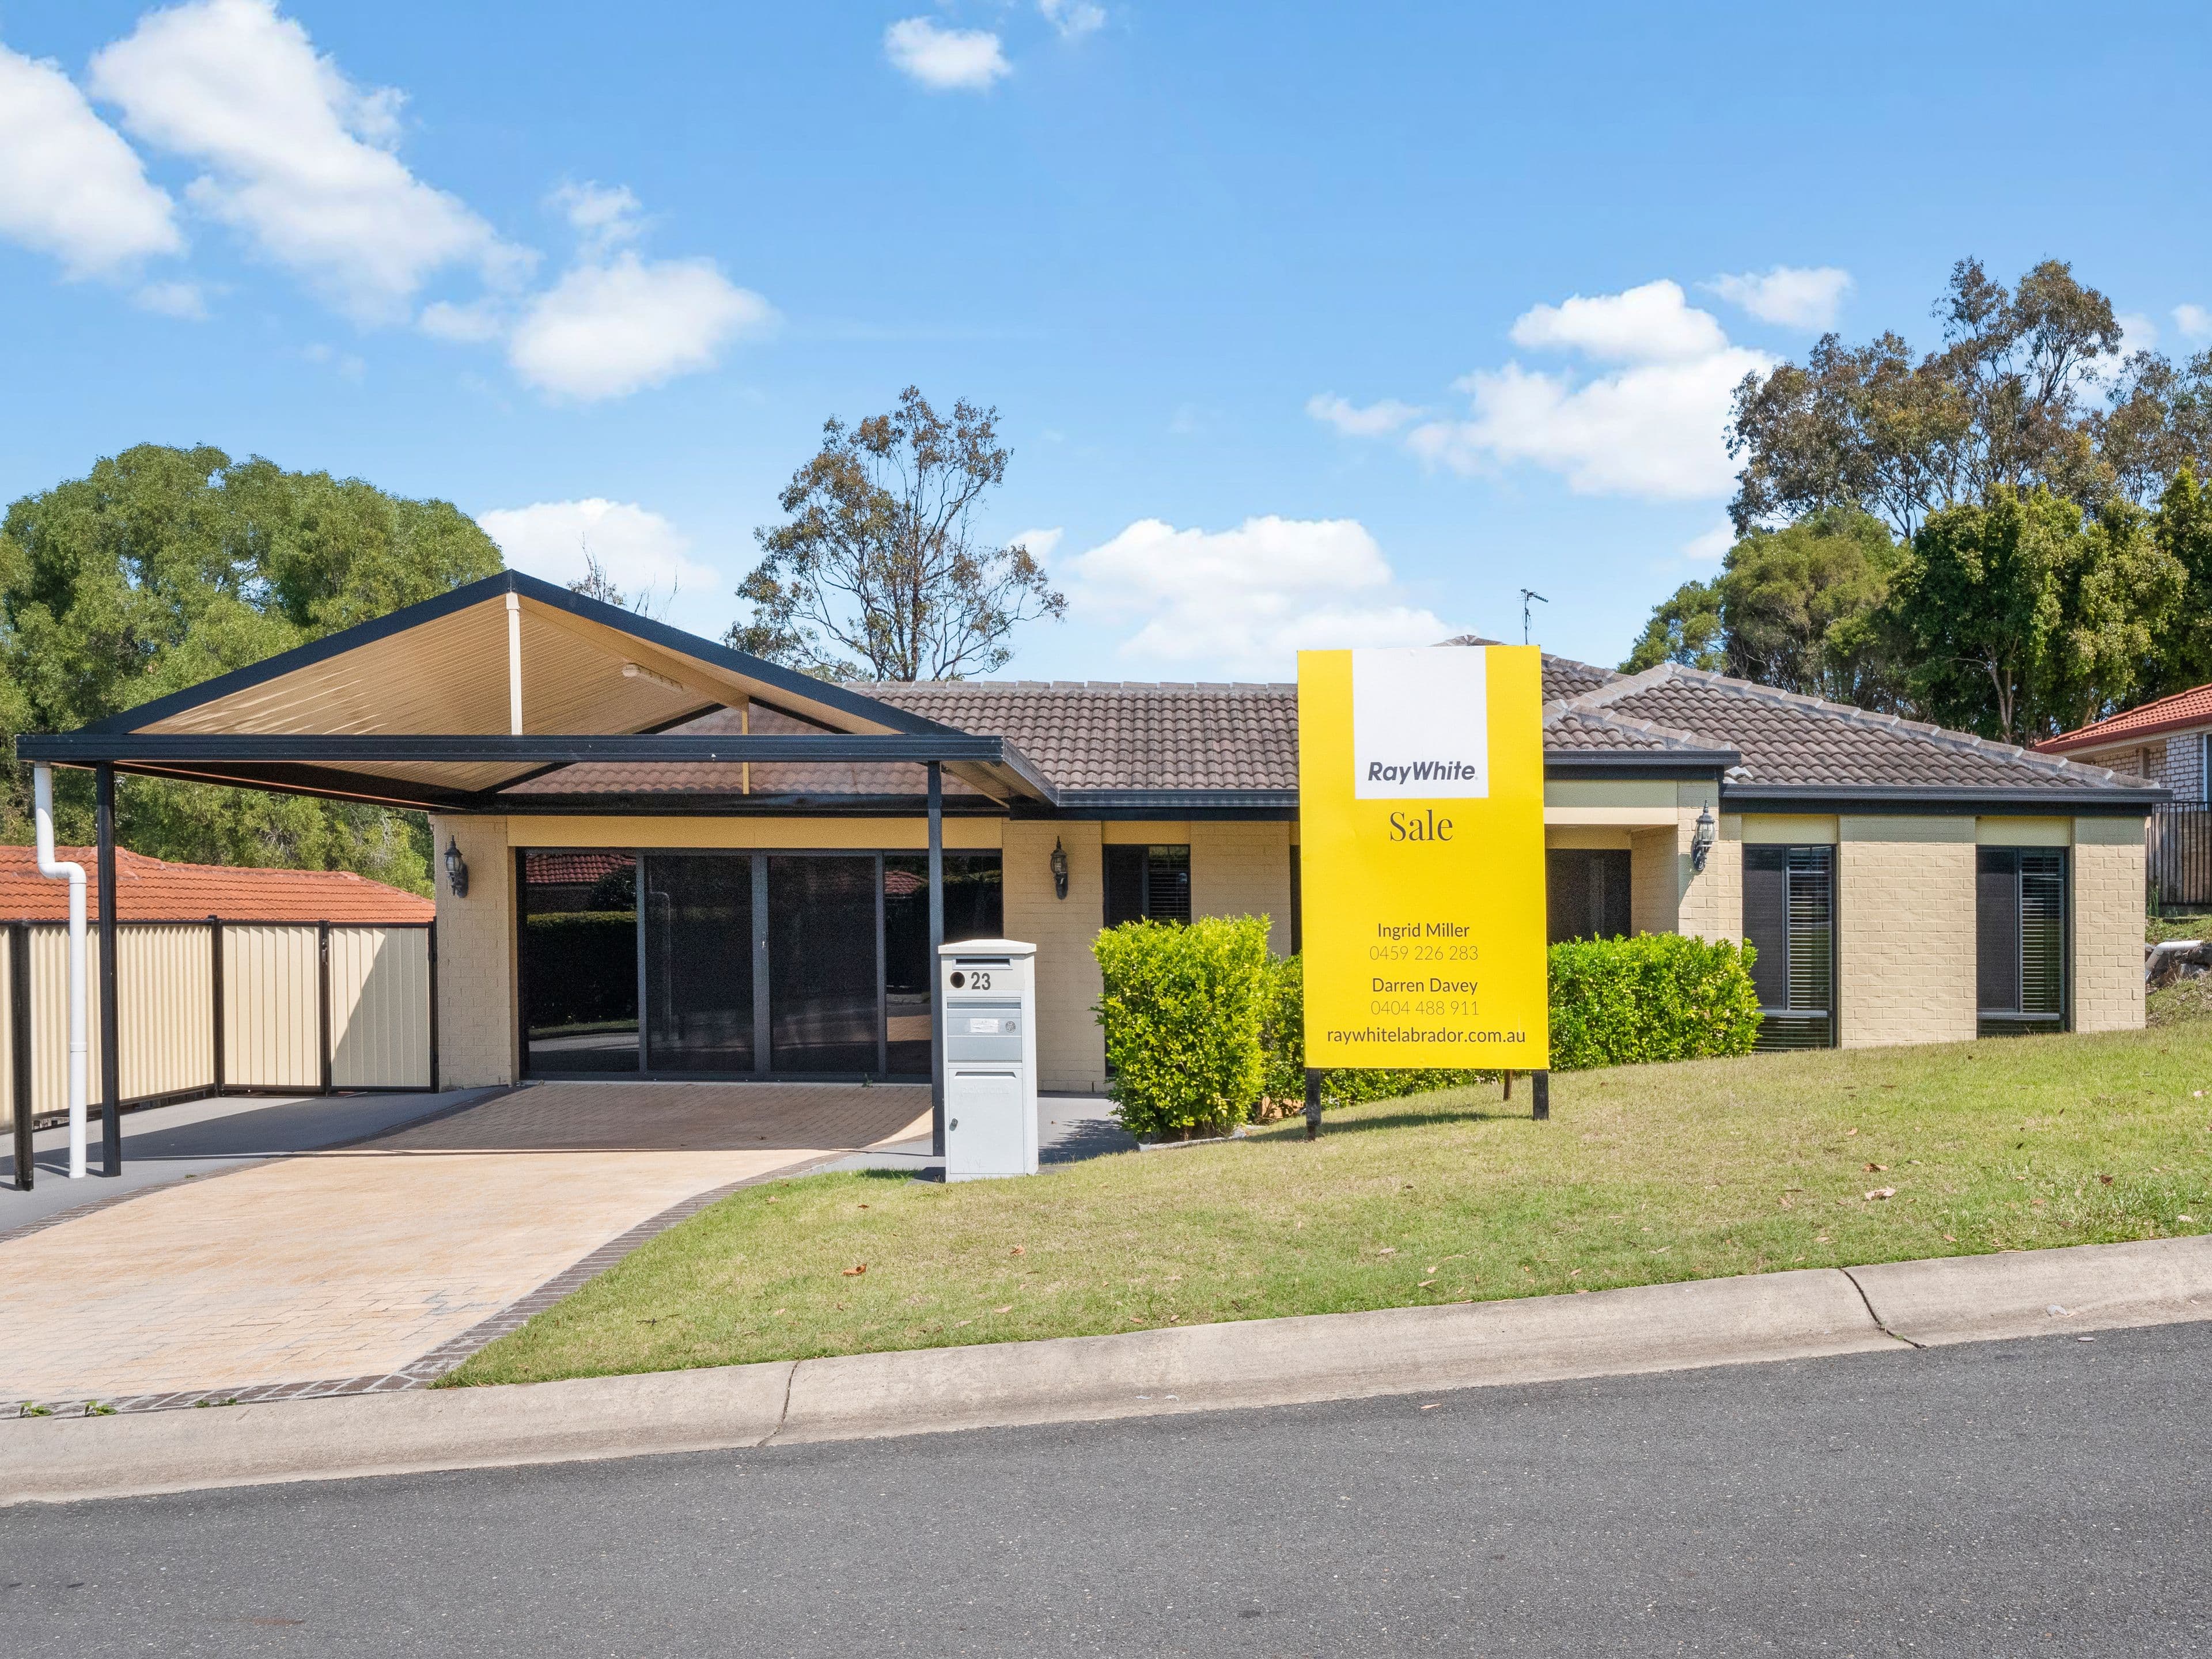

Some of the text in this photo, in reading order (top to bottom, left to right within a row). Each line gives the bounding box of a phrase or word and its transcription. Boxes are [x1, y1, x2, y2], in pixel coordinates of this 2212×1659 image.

[1390, 809, 1453, 842] Sale
[1378, 922, 1470, 940] Ingrid Miller
[1369, 945, 1478, 961] 0459 226 283
[971, 972, 991, 991] 23
[1372, 978, 1478, 995] Darren Davey
[1370, 1000, 1479, 1016] 0404 488 911
[1327, 1027, 1525, 1046] raywhitelabrador.com.au
